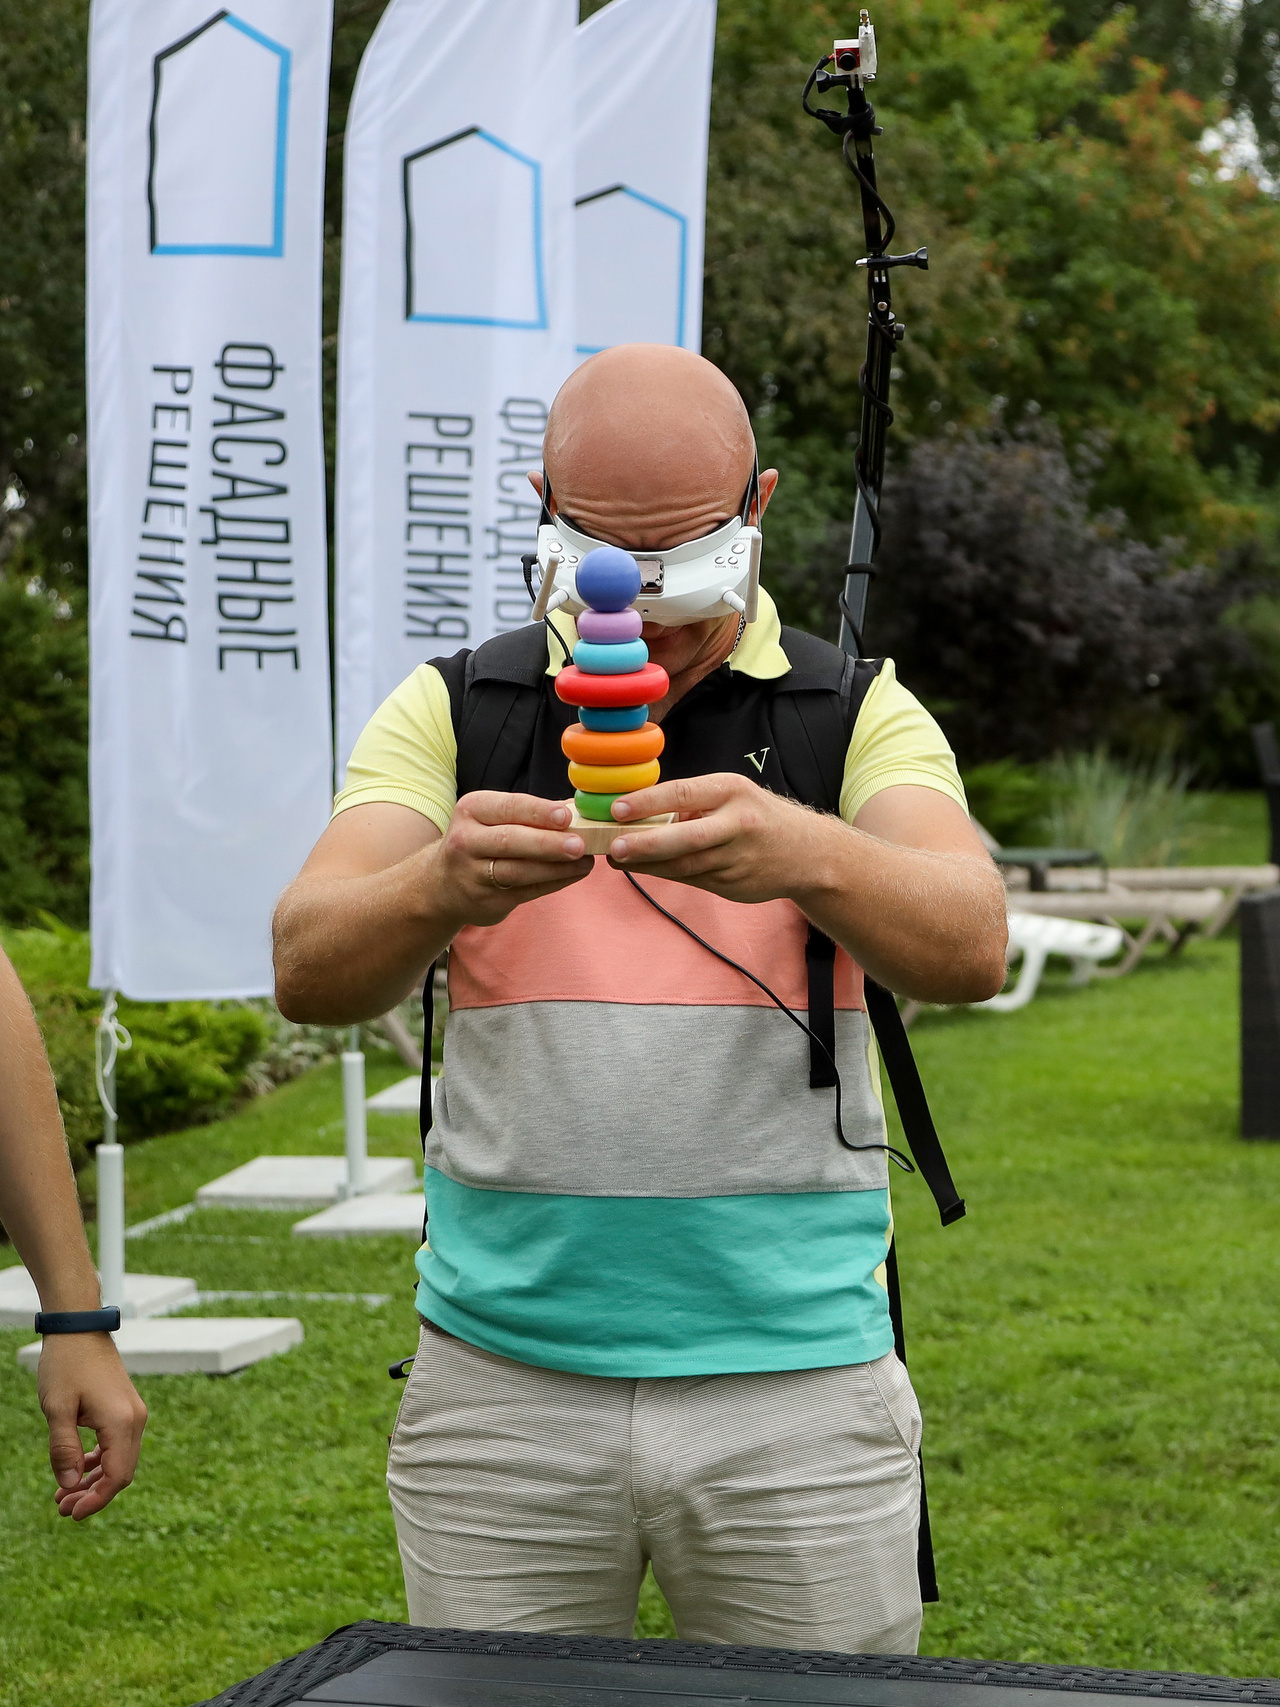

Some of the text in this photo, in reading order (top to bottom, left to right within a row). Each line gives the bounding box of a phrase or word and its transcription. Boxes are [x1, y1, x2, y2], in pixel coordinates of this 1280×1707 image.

[130, 364, 194, 644] РЕШЕНИЯ
[199, 340, 299, 672] ФАСАДНЫЕ
[404, 411, 475, 640] РЕШЕНИЯ
